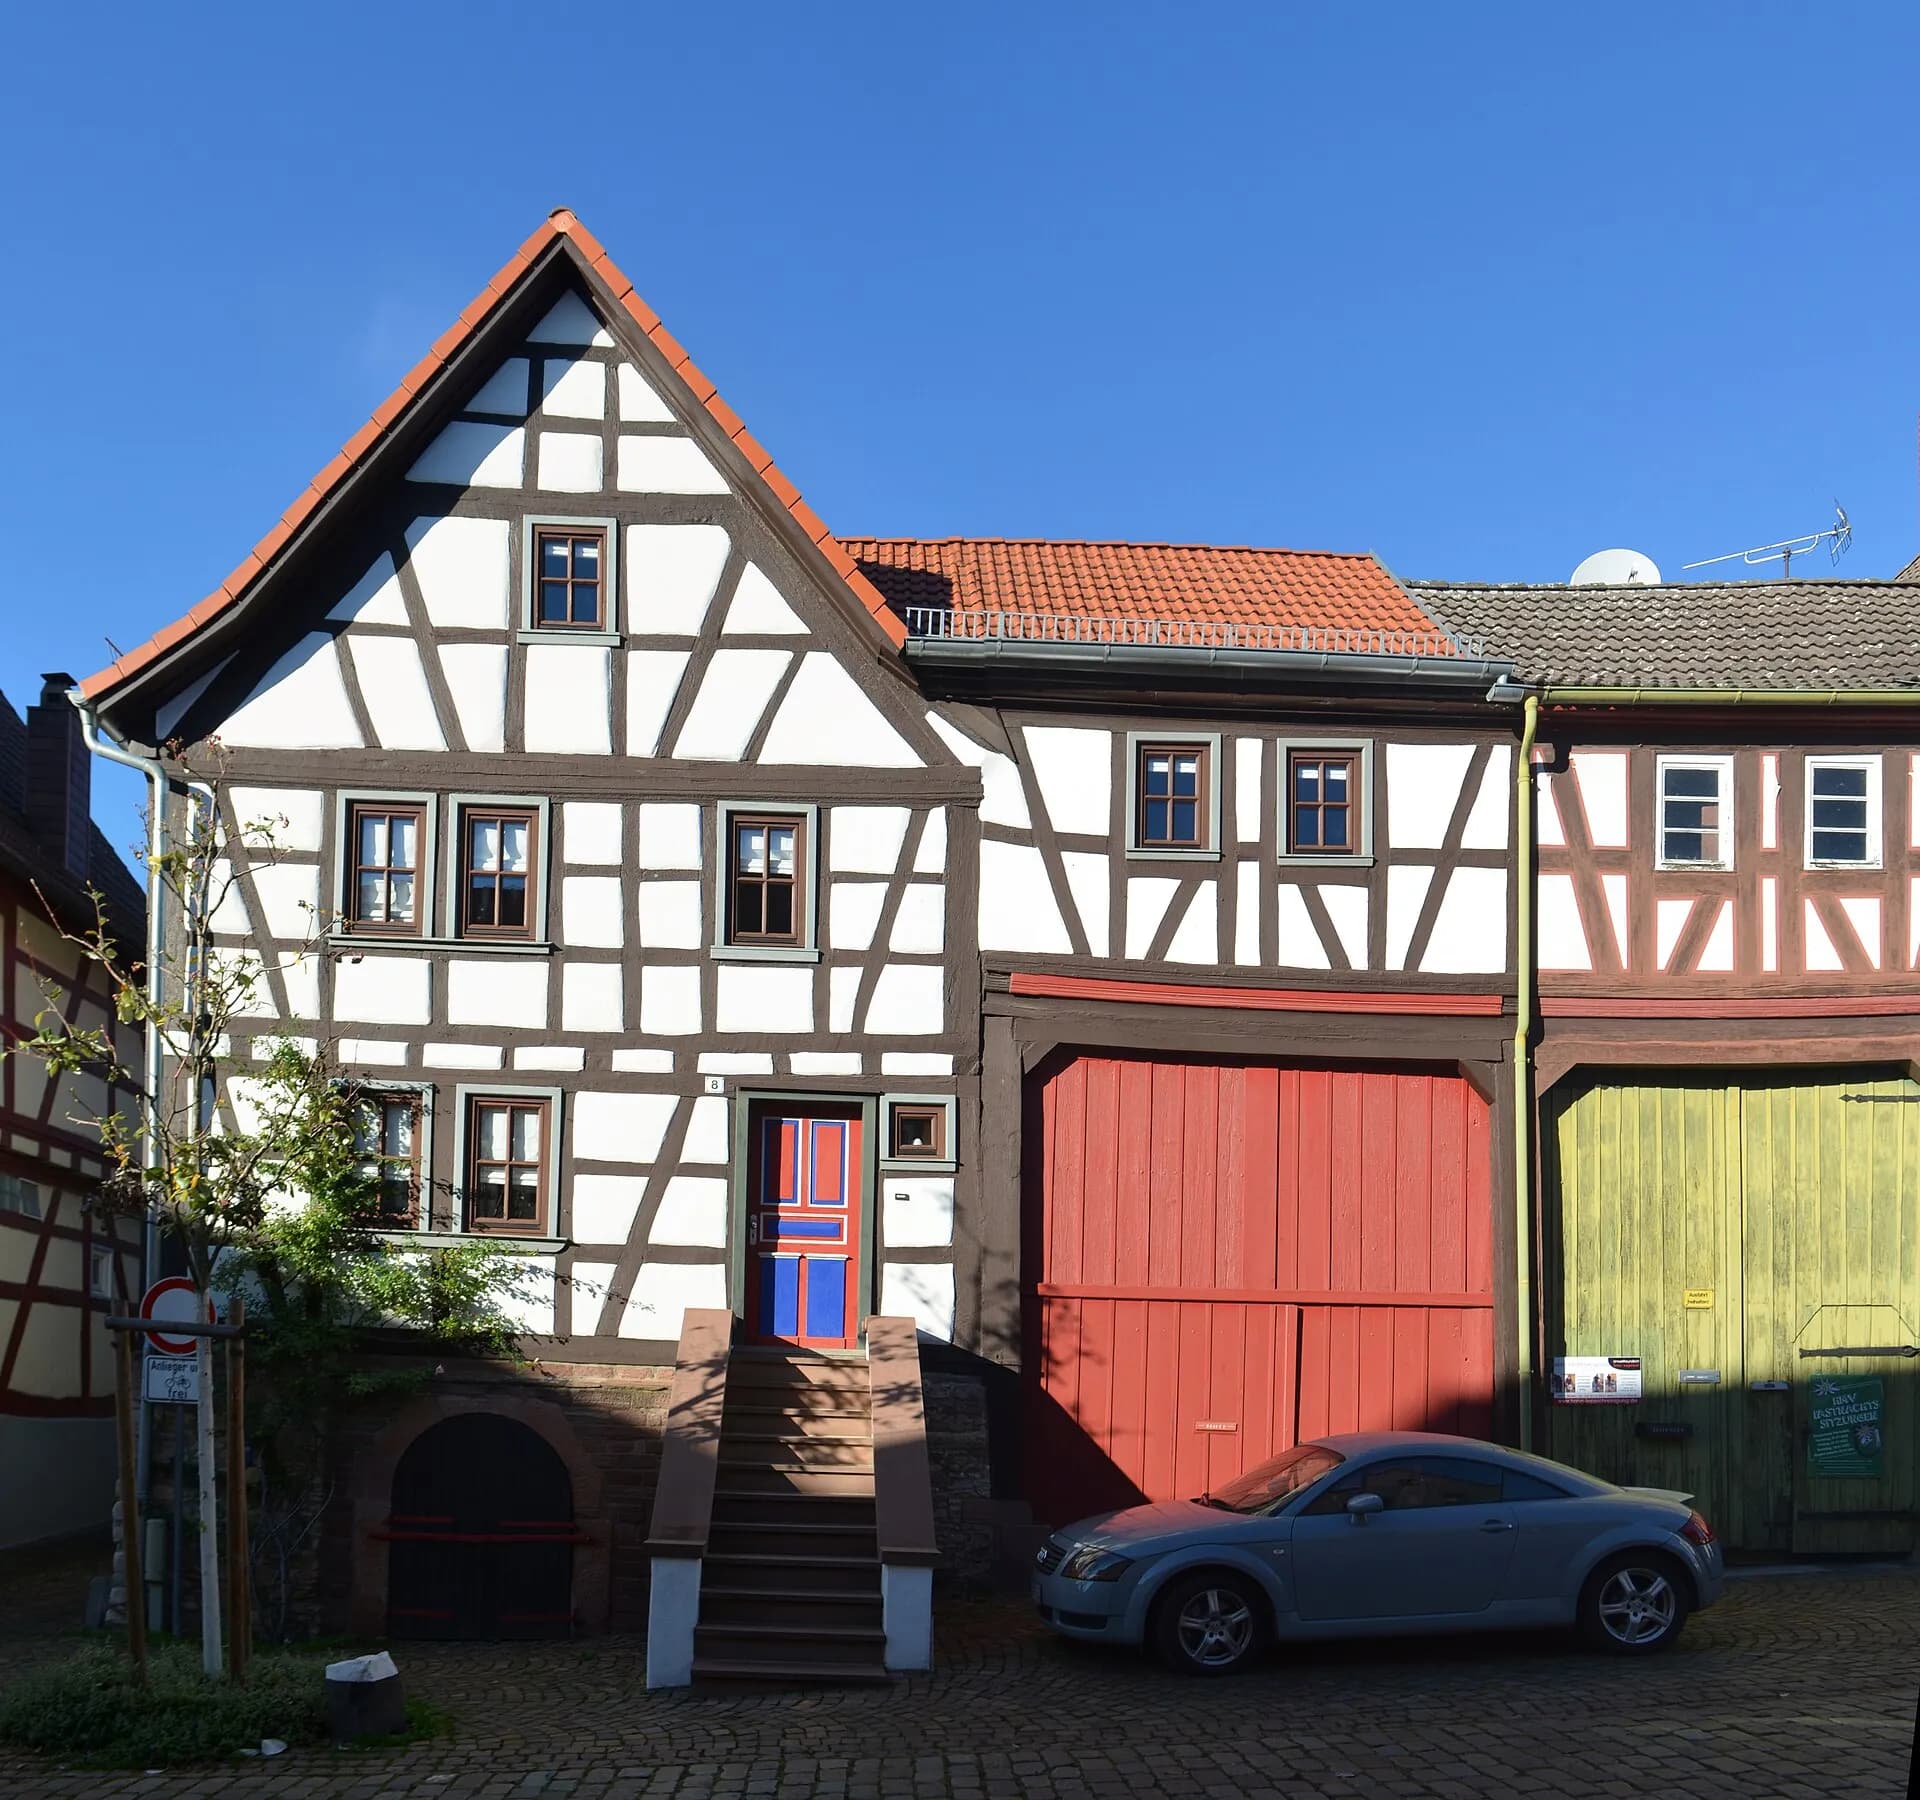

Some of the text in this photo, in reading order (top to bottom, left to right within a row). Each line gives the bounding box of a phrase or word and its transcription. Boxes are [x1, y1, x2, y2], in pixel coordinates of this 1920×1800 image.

[711, 1079, 718, 1090] 8
[151, 1360, 188, 1375] Anlieger
[168, 1388, 187, 1398] frei
